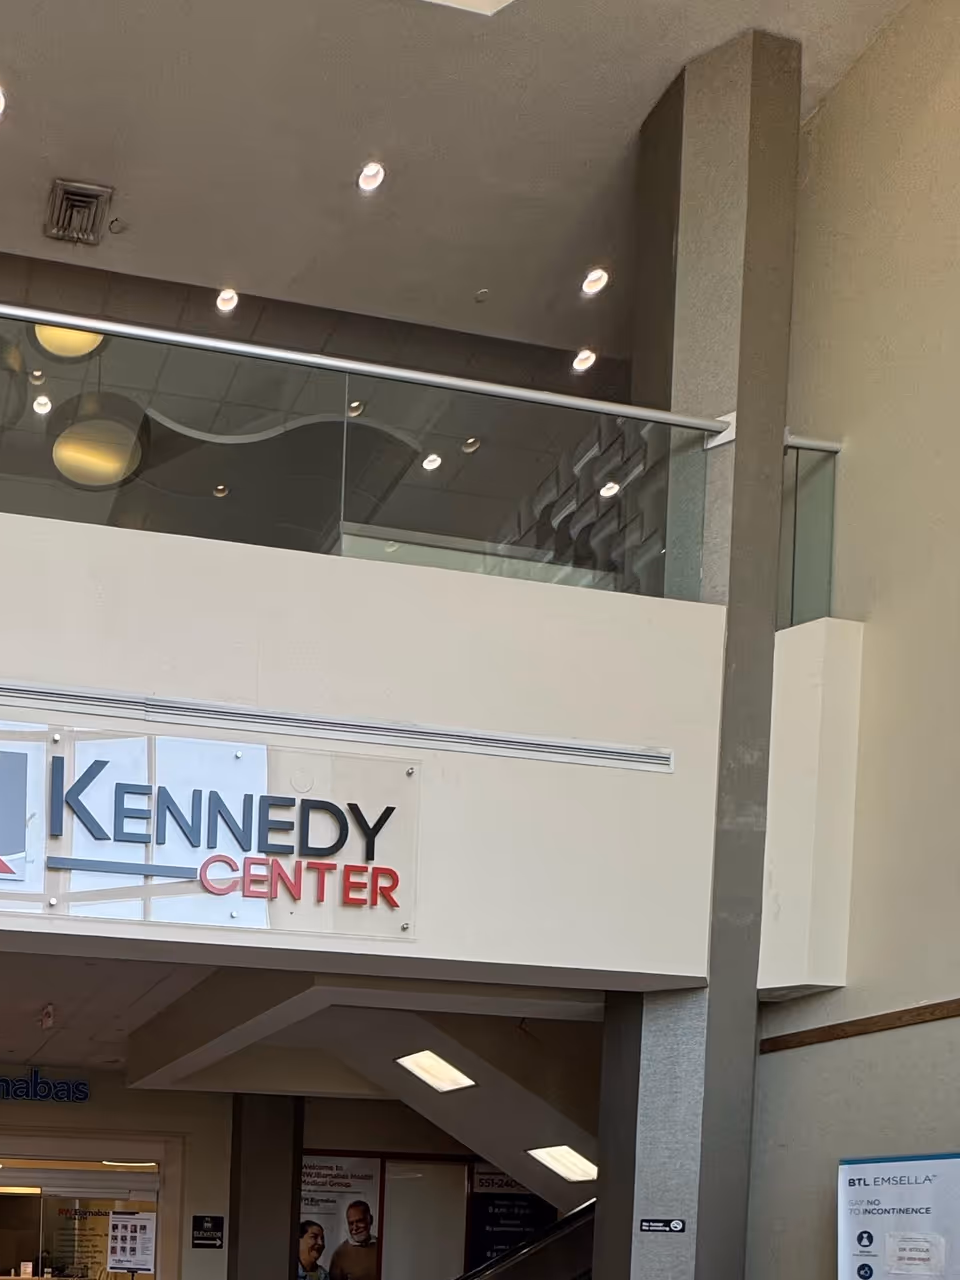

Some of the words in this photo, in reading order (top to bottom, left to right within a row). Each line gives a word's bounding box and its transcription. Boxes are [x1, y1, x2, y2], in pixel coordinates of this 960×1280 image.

[50, 755, 397, 862] KENNEDY
[199, 855, 401, 909] CENTER
[848, 1178, 870, 1187] BTL
[862, 1207, 932, 1215] INCONTINENCE
